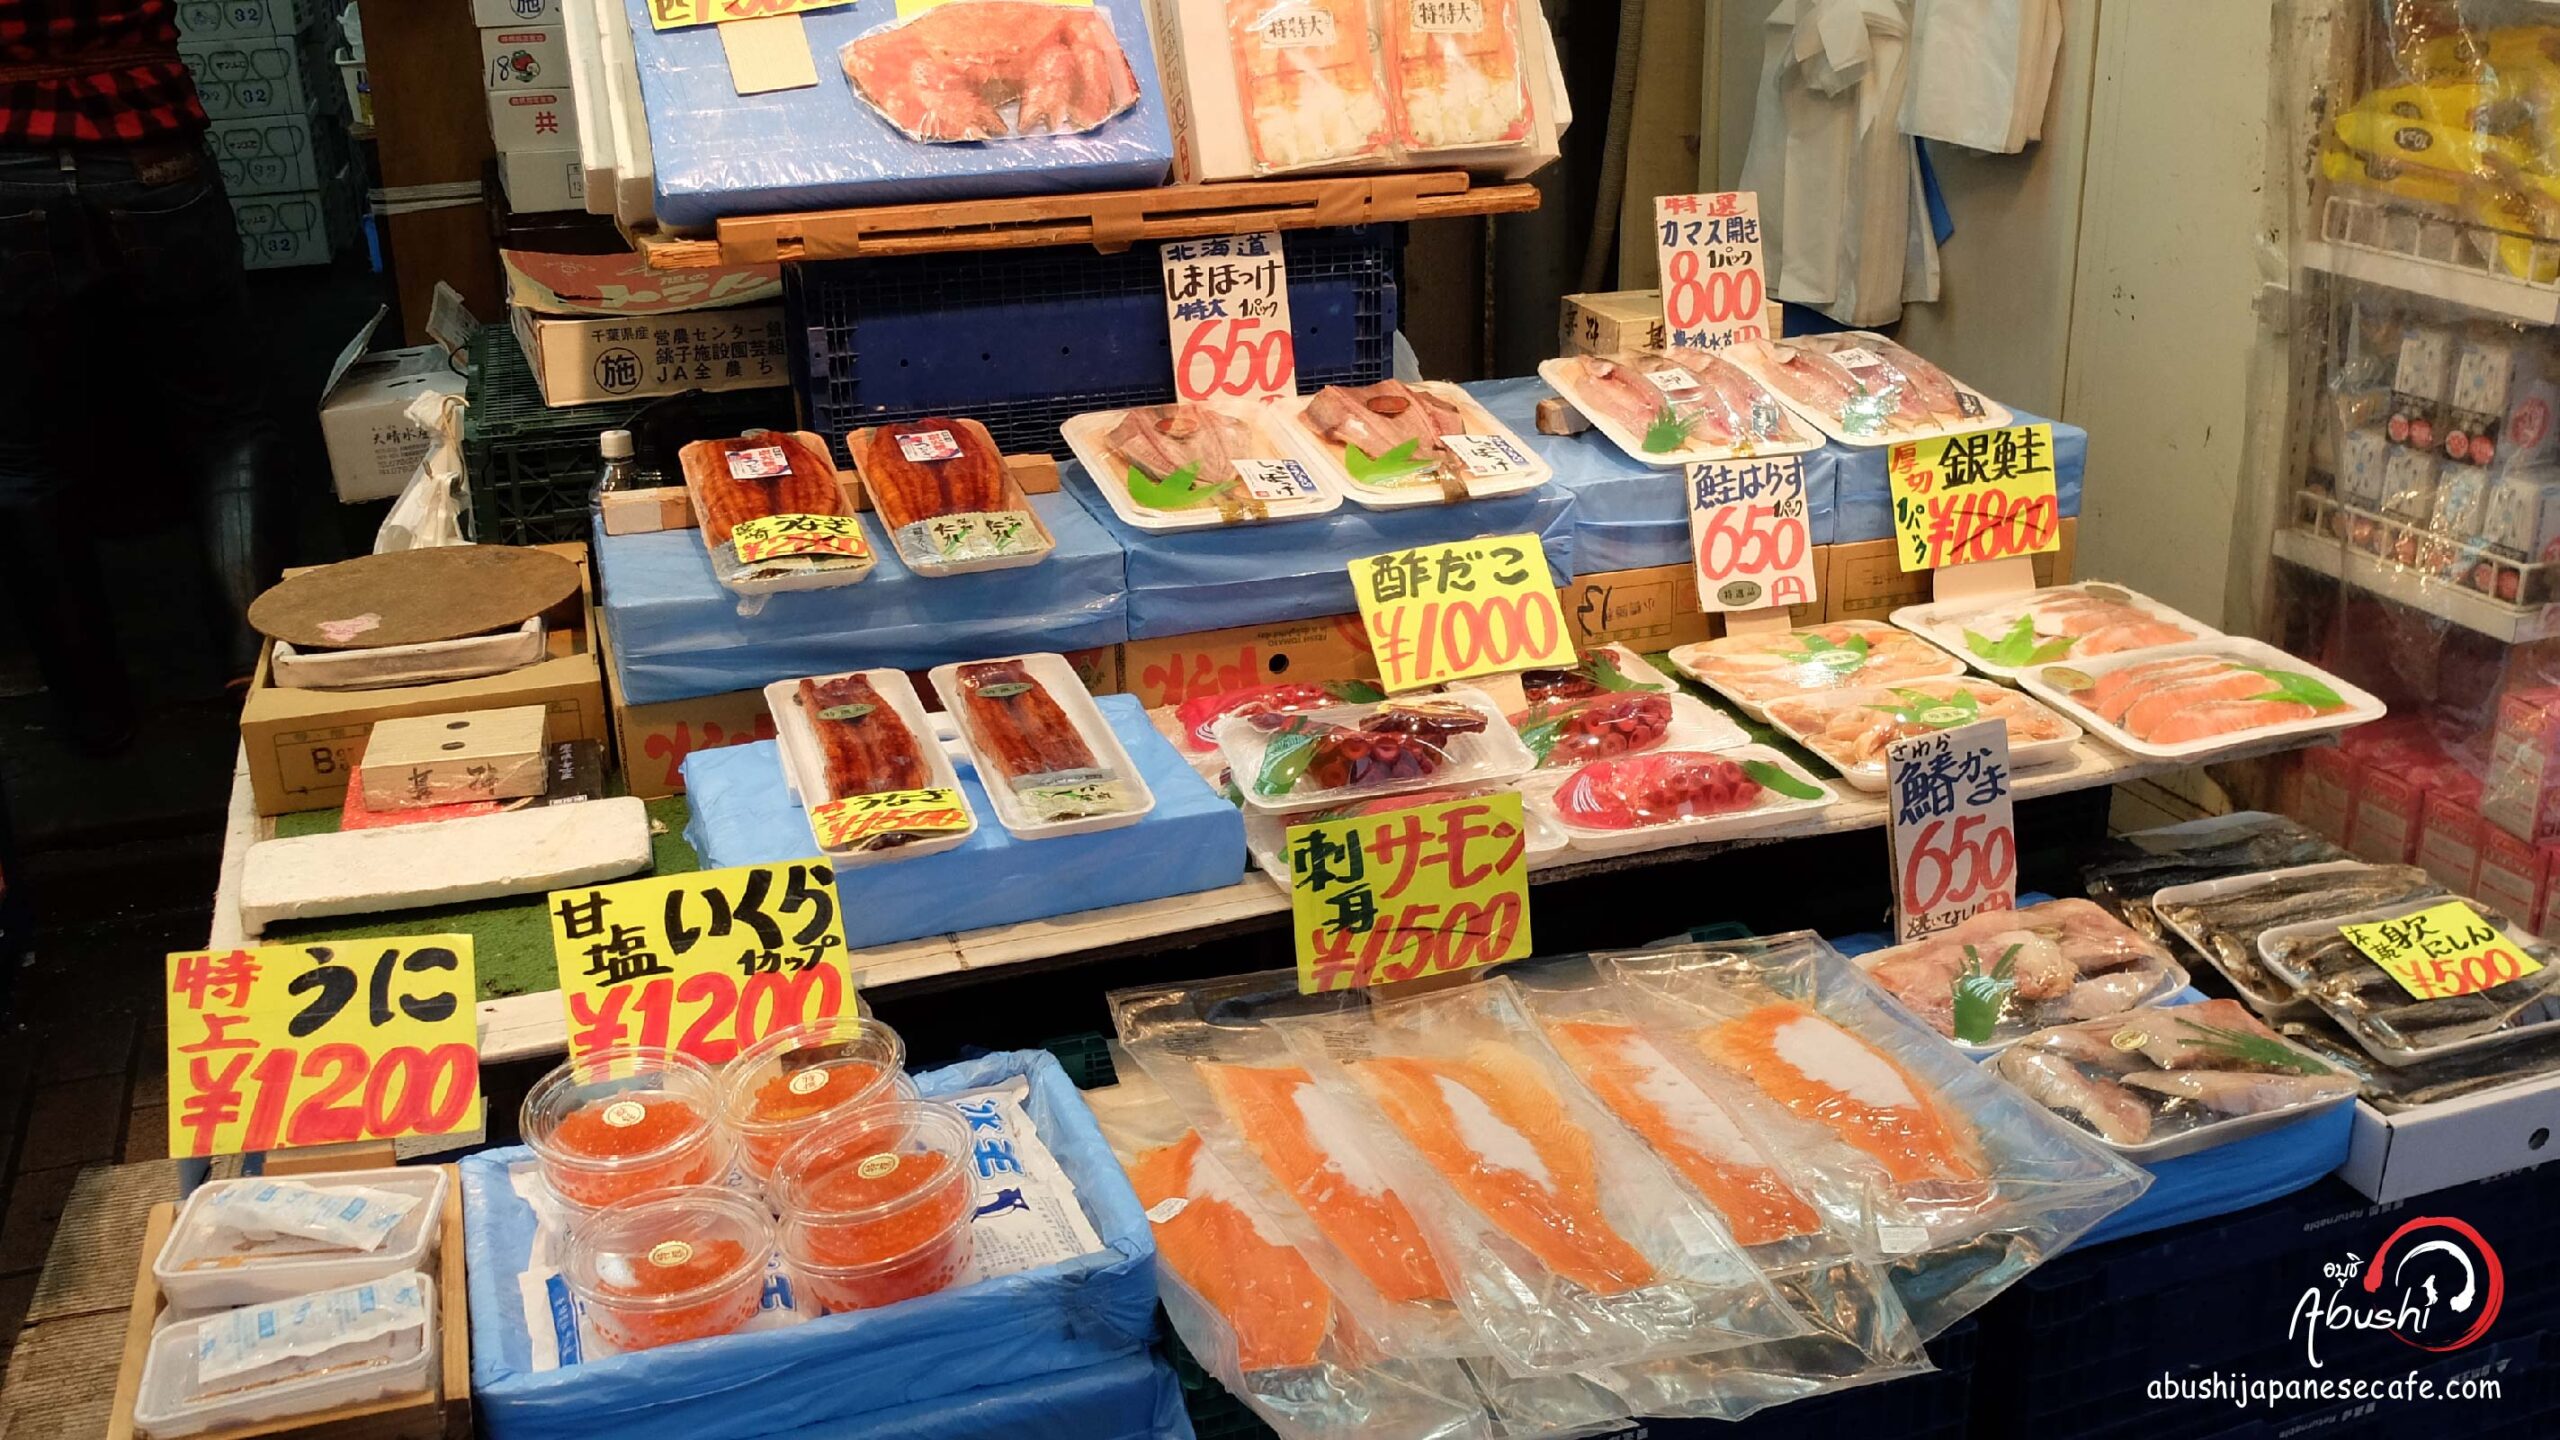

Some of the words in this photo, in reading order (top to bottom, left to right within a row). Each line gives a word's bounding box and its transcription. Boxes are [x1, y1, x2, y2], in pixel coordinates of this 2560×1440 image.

[235, 8, 259, 22] 32
[1418, 2, 1472, 24] 特特大
[490, 55, 510, 87] 18
[243, 89, 266, 103] 32
[535, 111, 558, 134] 共
[1664, 193, 1747, 217] 特選
[268, 238, 291, 252] 32
[1167, 232, 1270, 262] 北海道
[1660, 217, 1759, 247] カマス開き
[1707, 247, 1753, 268] 1パック
[1168, 260, 1283, 301] しまほっけ
[1667, 251, 1761, 329] 800
[1173, 299, 1228, 322] 特大
[1238, 298, 1278, 318] 1パック
[591, 326, 649, 342] 千葉県産
[601, 354, 636, 388] 施
[1177, 317, 1295, 401] 650
[1938, 427, 2051, 490] 銀鮭
[1693, 455, 1803, 511] 鮭はらす
[774, 516, 854, 534] うなぎ
[1700, 505, 1805, 581] 650
[1371, 547, 1529, 603] 酢だこ
[1267, 637, 1301, 647] TOMATO
[1892, 734, 1949, 762] さわら
[854, 789, 952, 811] うなぎ
[1365, 805, 1525, 899] サーモン
[1903, 813, 2015, 916] 650
[1293, 829, 1378, 935] 刺身
[664, 865, 835, 955] いくら
[554, 891, 674, 987] 甘塩
[737, 935, 841, 976] 1カップ
[2421, 926, 2495, 959] にしん
[2394, 949, 2521, 1000] ¥500
[173, 950, 262, 1053] 特上
[288, 947, 458, 1037] うに
[2303, 1208, 2364, 1232] Returnable
